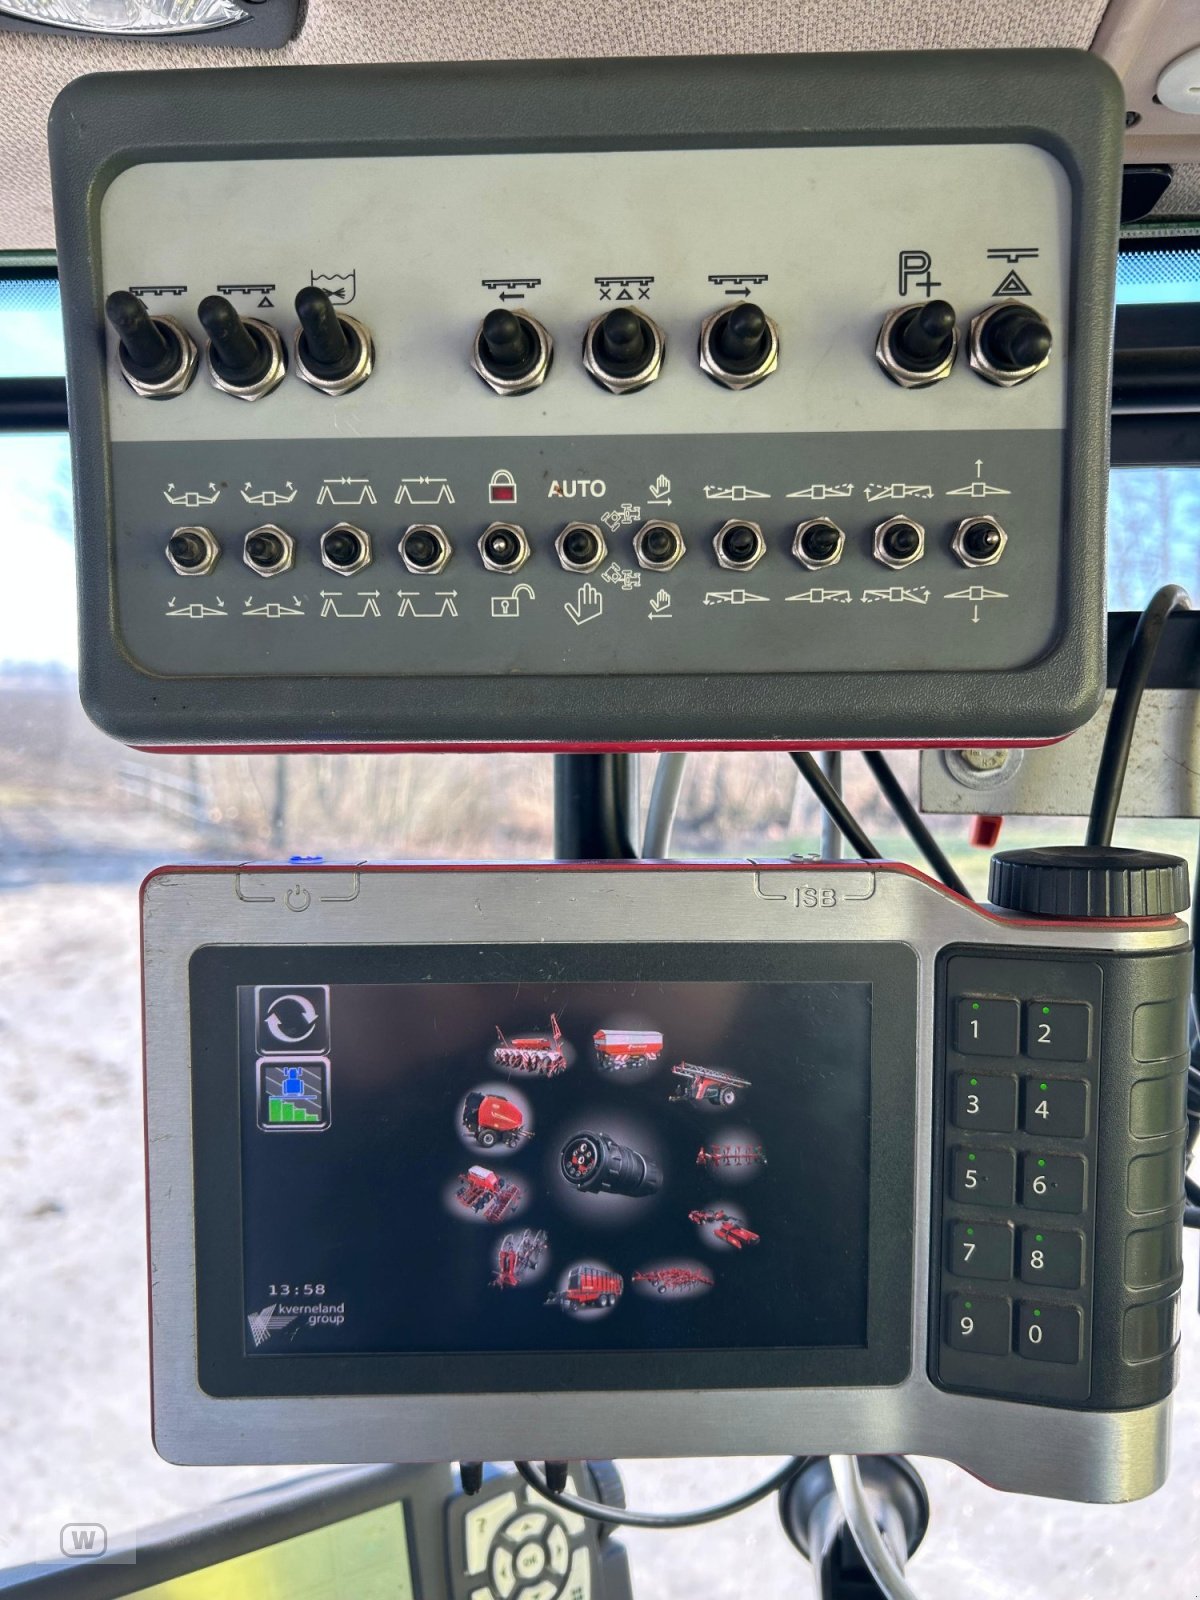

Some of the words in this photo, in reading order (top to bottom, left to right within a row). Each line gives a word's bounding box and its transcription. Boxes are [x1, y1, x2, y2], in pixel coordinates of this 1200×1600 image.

[547, 479, 606, 498] AUTO
[793, 887, 837, 908] ISB
[970, 1019, 978, 1039] 1
[1037, 1023, 1051, 1043] 2
[966, 1094, 980, 1114] 3
[1034, 1100, 1050, 1119] 4
[964, 1169, 977, 1189] 5
[1032, 1175, 1047, 1195] 6
[963, 1242, 976, 1262] 7
[1030, 1250, 1044, 1269] 8
[268, 1283, 326, 1296] 13:58
[278, 1302, 345, 1314] kverneland
[308, 1315, 345, 1327] group
[960, 1316, 974, 1335] 9
[1028, 1324, 1042, 1343] 0
